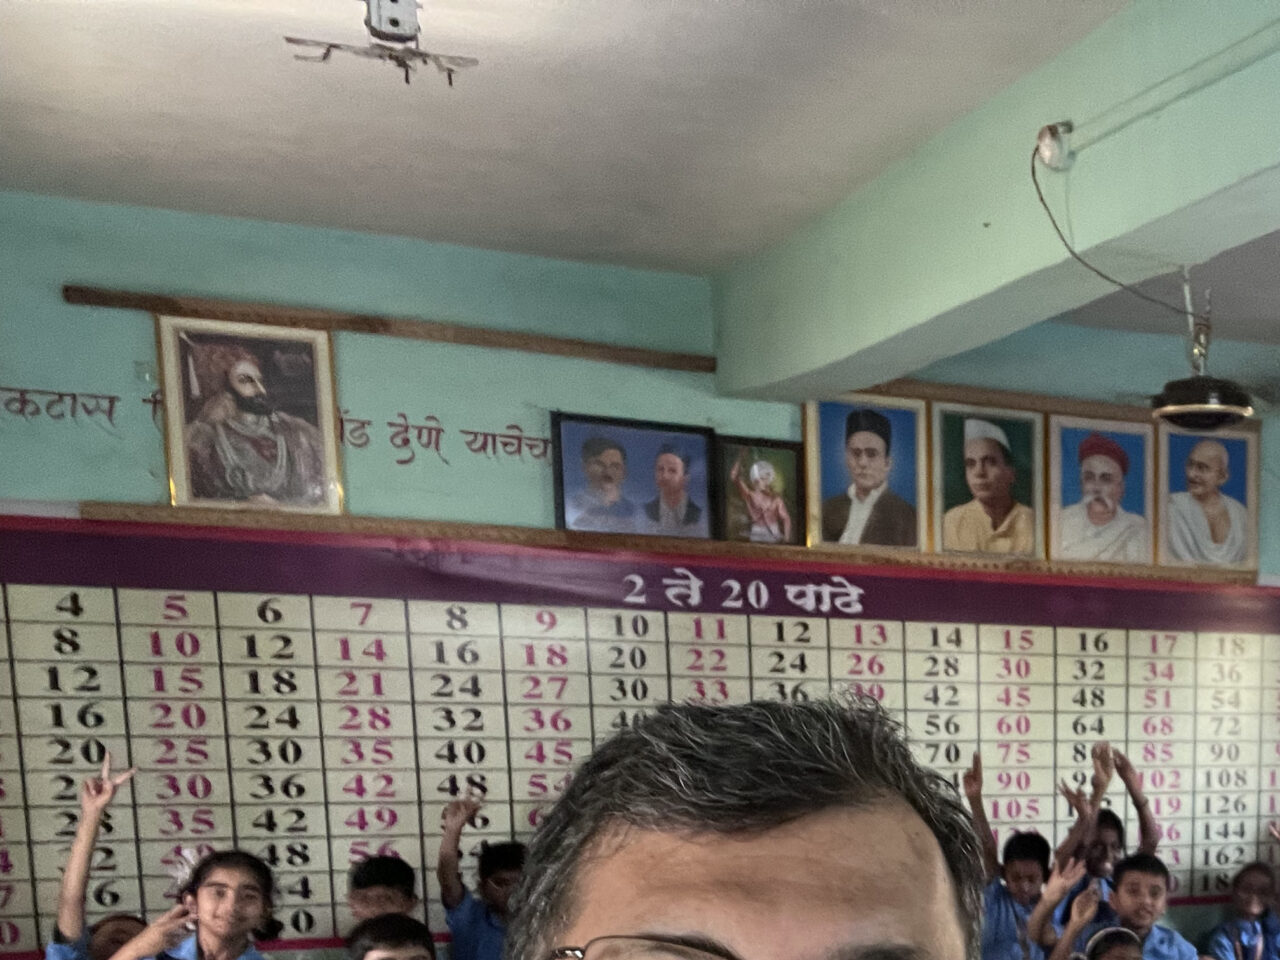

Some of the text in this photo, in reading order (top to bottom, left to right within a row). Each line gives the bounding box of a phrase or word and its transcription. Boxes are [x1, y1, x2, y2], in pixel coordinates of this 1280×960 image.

[623, 574, 646, 604] 2
[662, 568, 704, 607] ते
[721, 579, 769, 609] 20
[56, 592, 83, 617] 4
[164, 595, 187, 620] 5
[257, 599, 282, 623] 6
[350, 602, 373, 626] 7
[446, 604, 468, 629] 8
[536, 610, 557, 630] 9
[614, 615, 649, 637] 10
[694, 618, 725, 639] 11
[773, 622, 810, 643] 12
[855, 624, 887, 645] 13
[931, 627, 962, 647] 14
[1004, 630, 1033, 650] 15
[1080, 633, 1108, 651] 16
[1150, 634, 1178, 654] 17
[1218, 637, 1244, 654] 18
[54, 629, 80, 654] 8
[150, 631, 200, 657] 10
[245, 635, 293, 659] 12
[340, 638, 386, 661] 14
[436, 641, 479, 664] 16
[526, 645, 568, 666] 18
[610, 647, 646, 669] 20
[687, 648, 726, 671] 22
[770, 651, 807, 673] 24
[849, 653, 884, 675] 26
[925, 656, 959, 676] 28
[997, 658, 1030, 678] 30
[1074, 660, 1104, 680] 32
[1143, 662, 1174, 681] 34
[1212, 663, 1242, 683] 36
[48, 665, 100, 692] 12
[153, 667, 203, 693] 15
[248, 670, 297, 694] 18
[339, 670, 383, 696] 21
[432, 674, 482, 697] 24
[523, 675, 568, 699] 27
[611, 678, 648, 701] 30
[771, 682, 808, 700] 36
[924, 685, 958, 706] 42
[997, 687, 1030, 707] 45
[1073, 688, 1104, 707] 48
[1144, 689, 1170, 708] 51
[1212, 690, 1241, 710] 54
[51, 703, 104, 728] 16
[152, 703, 206, 728] 20
[247, 705, 300, 729] 24
[340, 705, 391, 730] 28
[434, 707, 483, 731] 32
[525, 709, 572, 731] 36
[925, 714, 960, 735] 56
[997, 716, 1030, 734] 60
[1072, 716, 1104, 735] 64
[1143, 716, 1173, 735] 68
[1211, 717, 1241, 736] 72
[50, 738, 106, 764] 20
[154, 735, 209, 764] 25
[248, 737, 302, 764] 30
[341, 739, 393, 764] 35
[435, 740, 485, 764] 40
[525, 738, 573, 765] 45
[926, 742, 960, 763] 70
[995, 744, 1030, 763] 75
[1142, 743, 1172, 762] 85
[1210, 741, 1240, 761] 90
[157, 774, 212, 799] 30
[251, 774, 305, 799] 36
[343, 774, 395, 798] 42
[997, 772, 1030, 790] 90
[1203, 770, 1247, 788] 108
[161, 809, 214, 835] 35
[252, 809, 307, 832] 42
[345, 808, 398, 831] 49
[992, 799, 1039, 820] 105
[1205, 795, 1246, 814] 126
[1205, 822, 1245, 840] 144
[1203, 847, 1244, 865] 162
